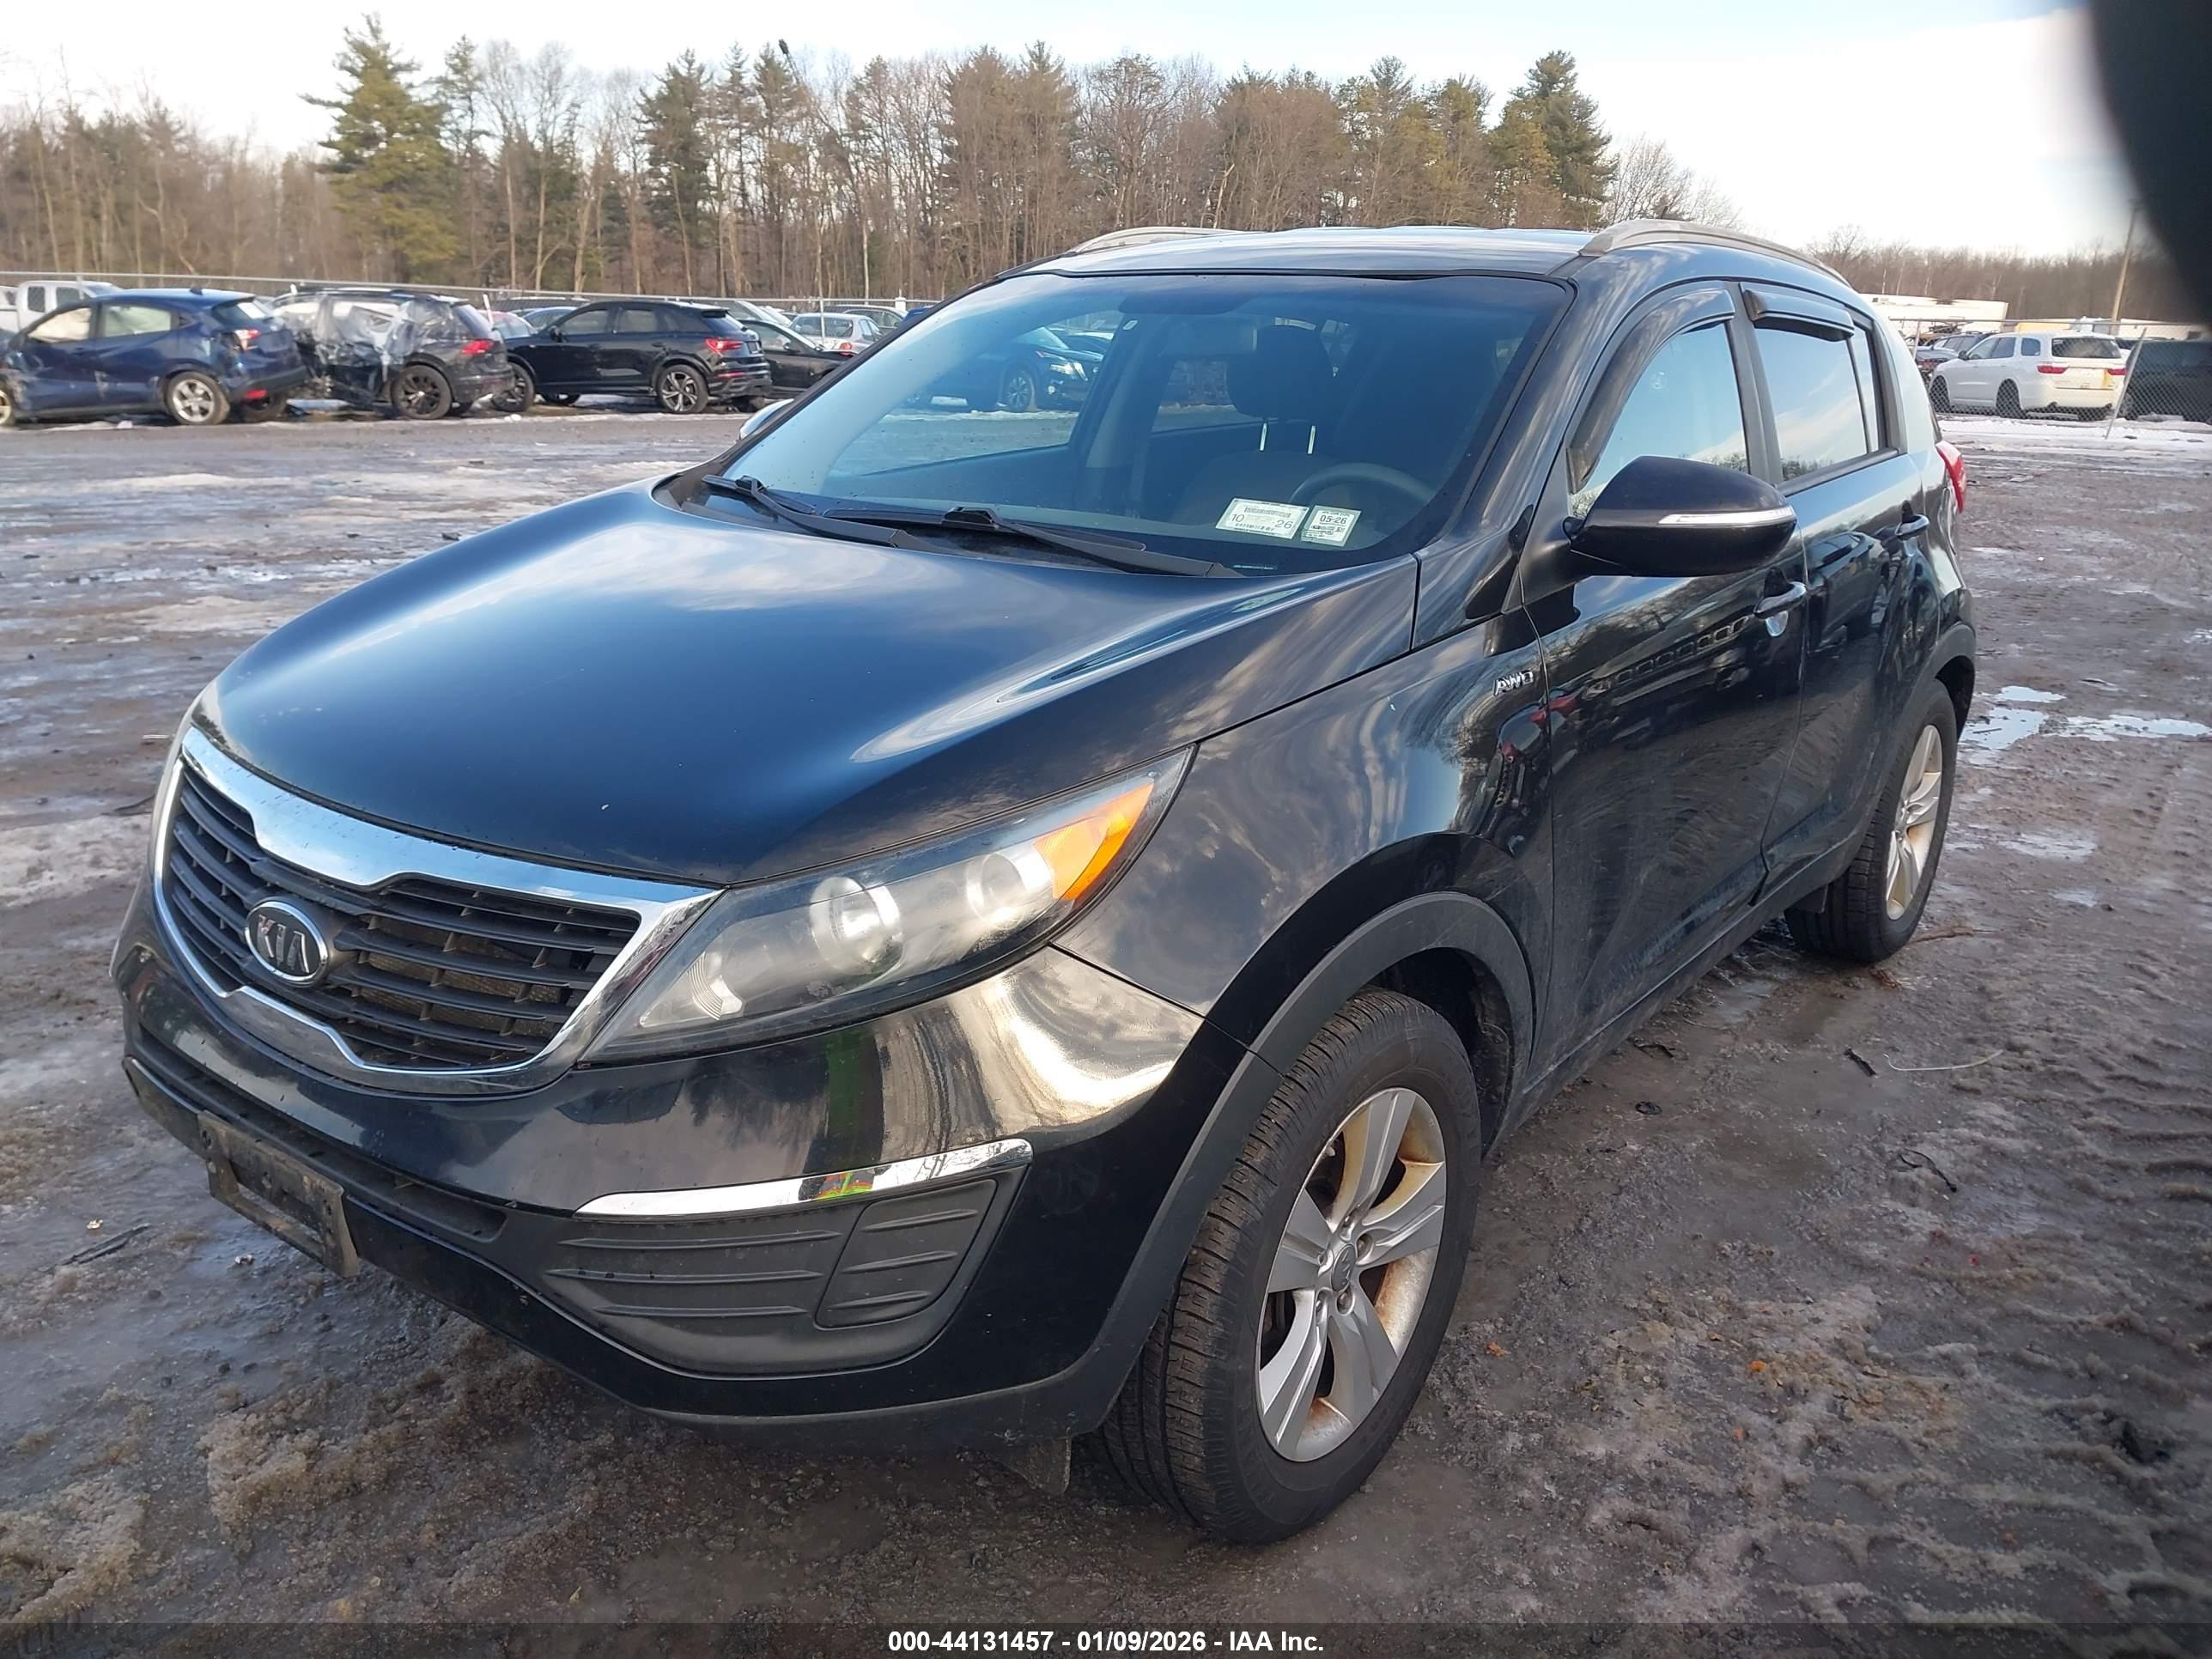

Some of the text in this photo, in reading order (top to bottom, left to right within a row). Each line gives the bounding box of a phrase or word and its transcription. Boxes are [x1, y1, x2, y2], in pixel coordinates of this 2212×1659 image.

[1231, 514, 1245, 522] 10
[1274, 520, 1293, 529] 26
[1493, 672, 1534, 696] AWD
[257, 914, 309, 973] KIA
